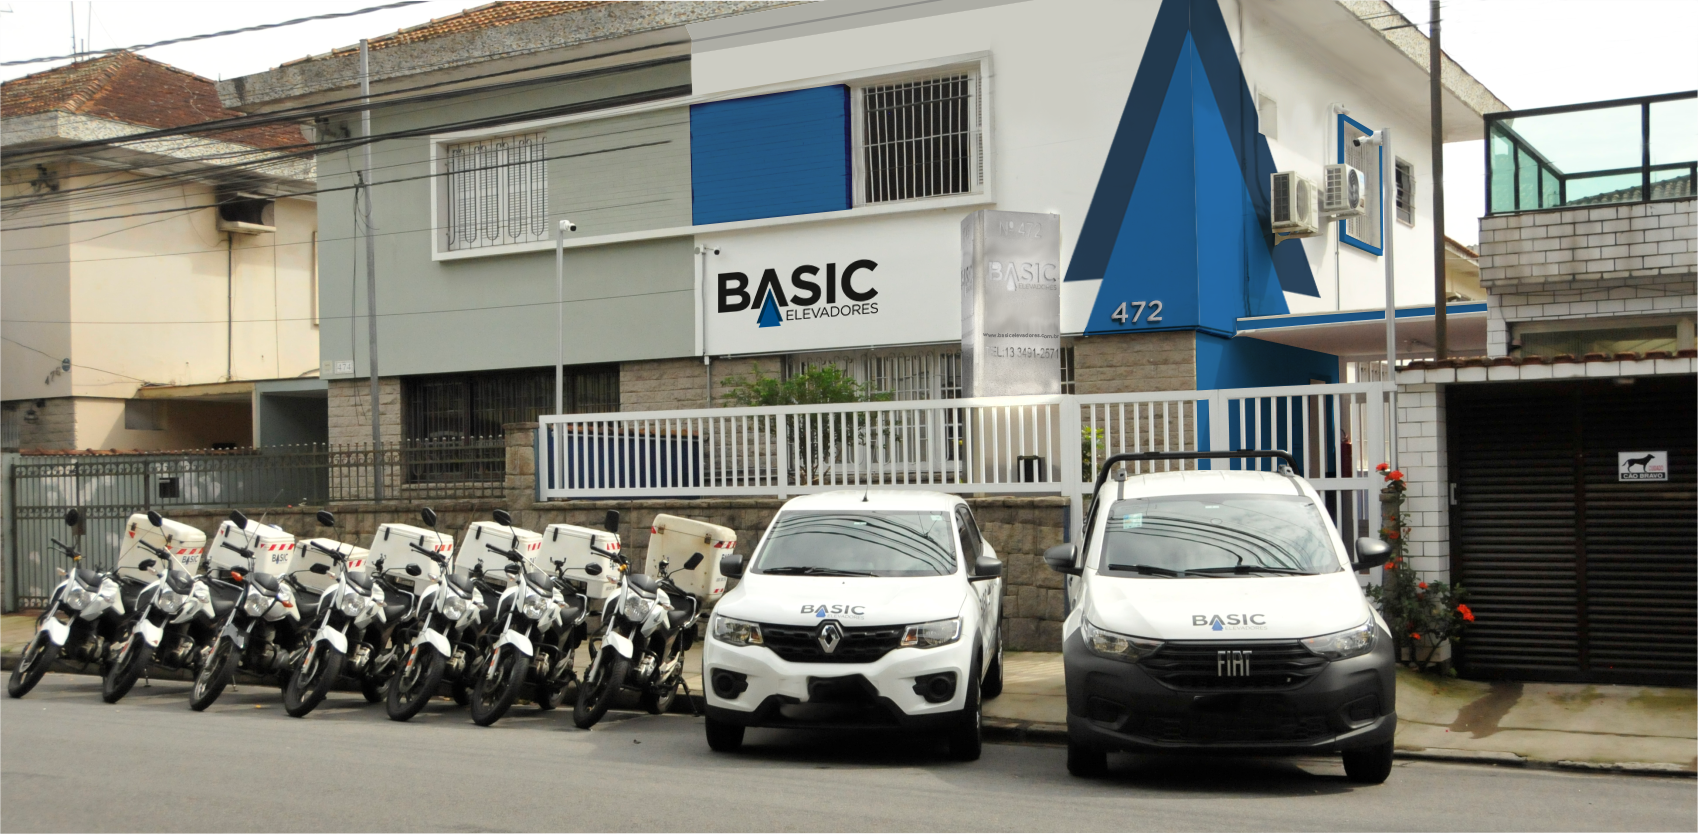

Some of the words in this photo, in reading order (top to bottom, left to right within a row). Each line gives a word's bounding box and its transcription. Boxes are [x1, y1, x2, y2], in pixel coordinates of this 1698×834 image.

[1018, 221, 1043, 238] 472
[988, 261, 1057, 282] BASIC
[718, 259, 878, 314] BASIC
[1018, 282, 1057, 291] ELEVADORES
[786, 303, 879, 321] ELEVADORES
[1111, 300, 1163, 323] 472
[1017, 347, 1059, 359] 3491-2571
[182, 555, 199, 563] BASIC
[272, 554, 288, 562] BASIC
[800, 604, 866, 615] BASIC
[1192, 613, 1267, 626] BASIC
[1217, 650, 1253, 677] FIAT
